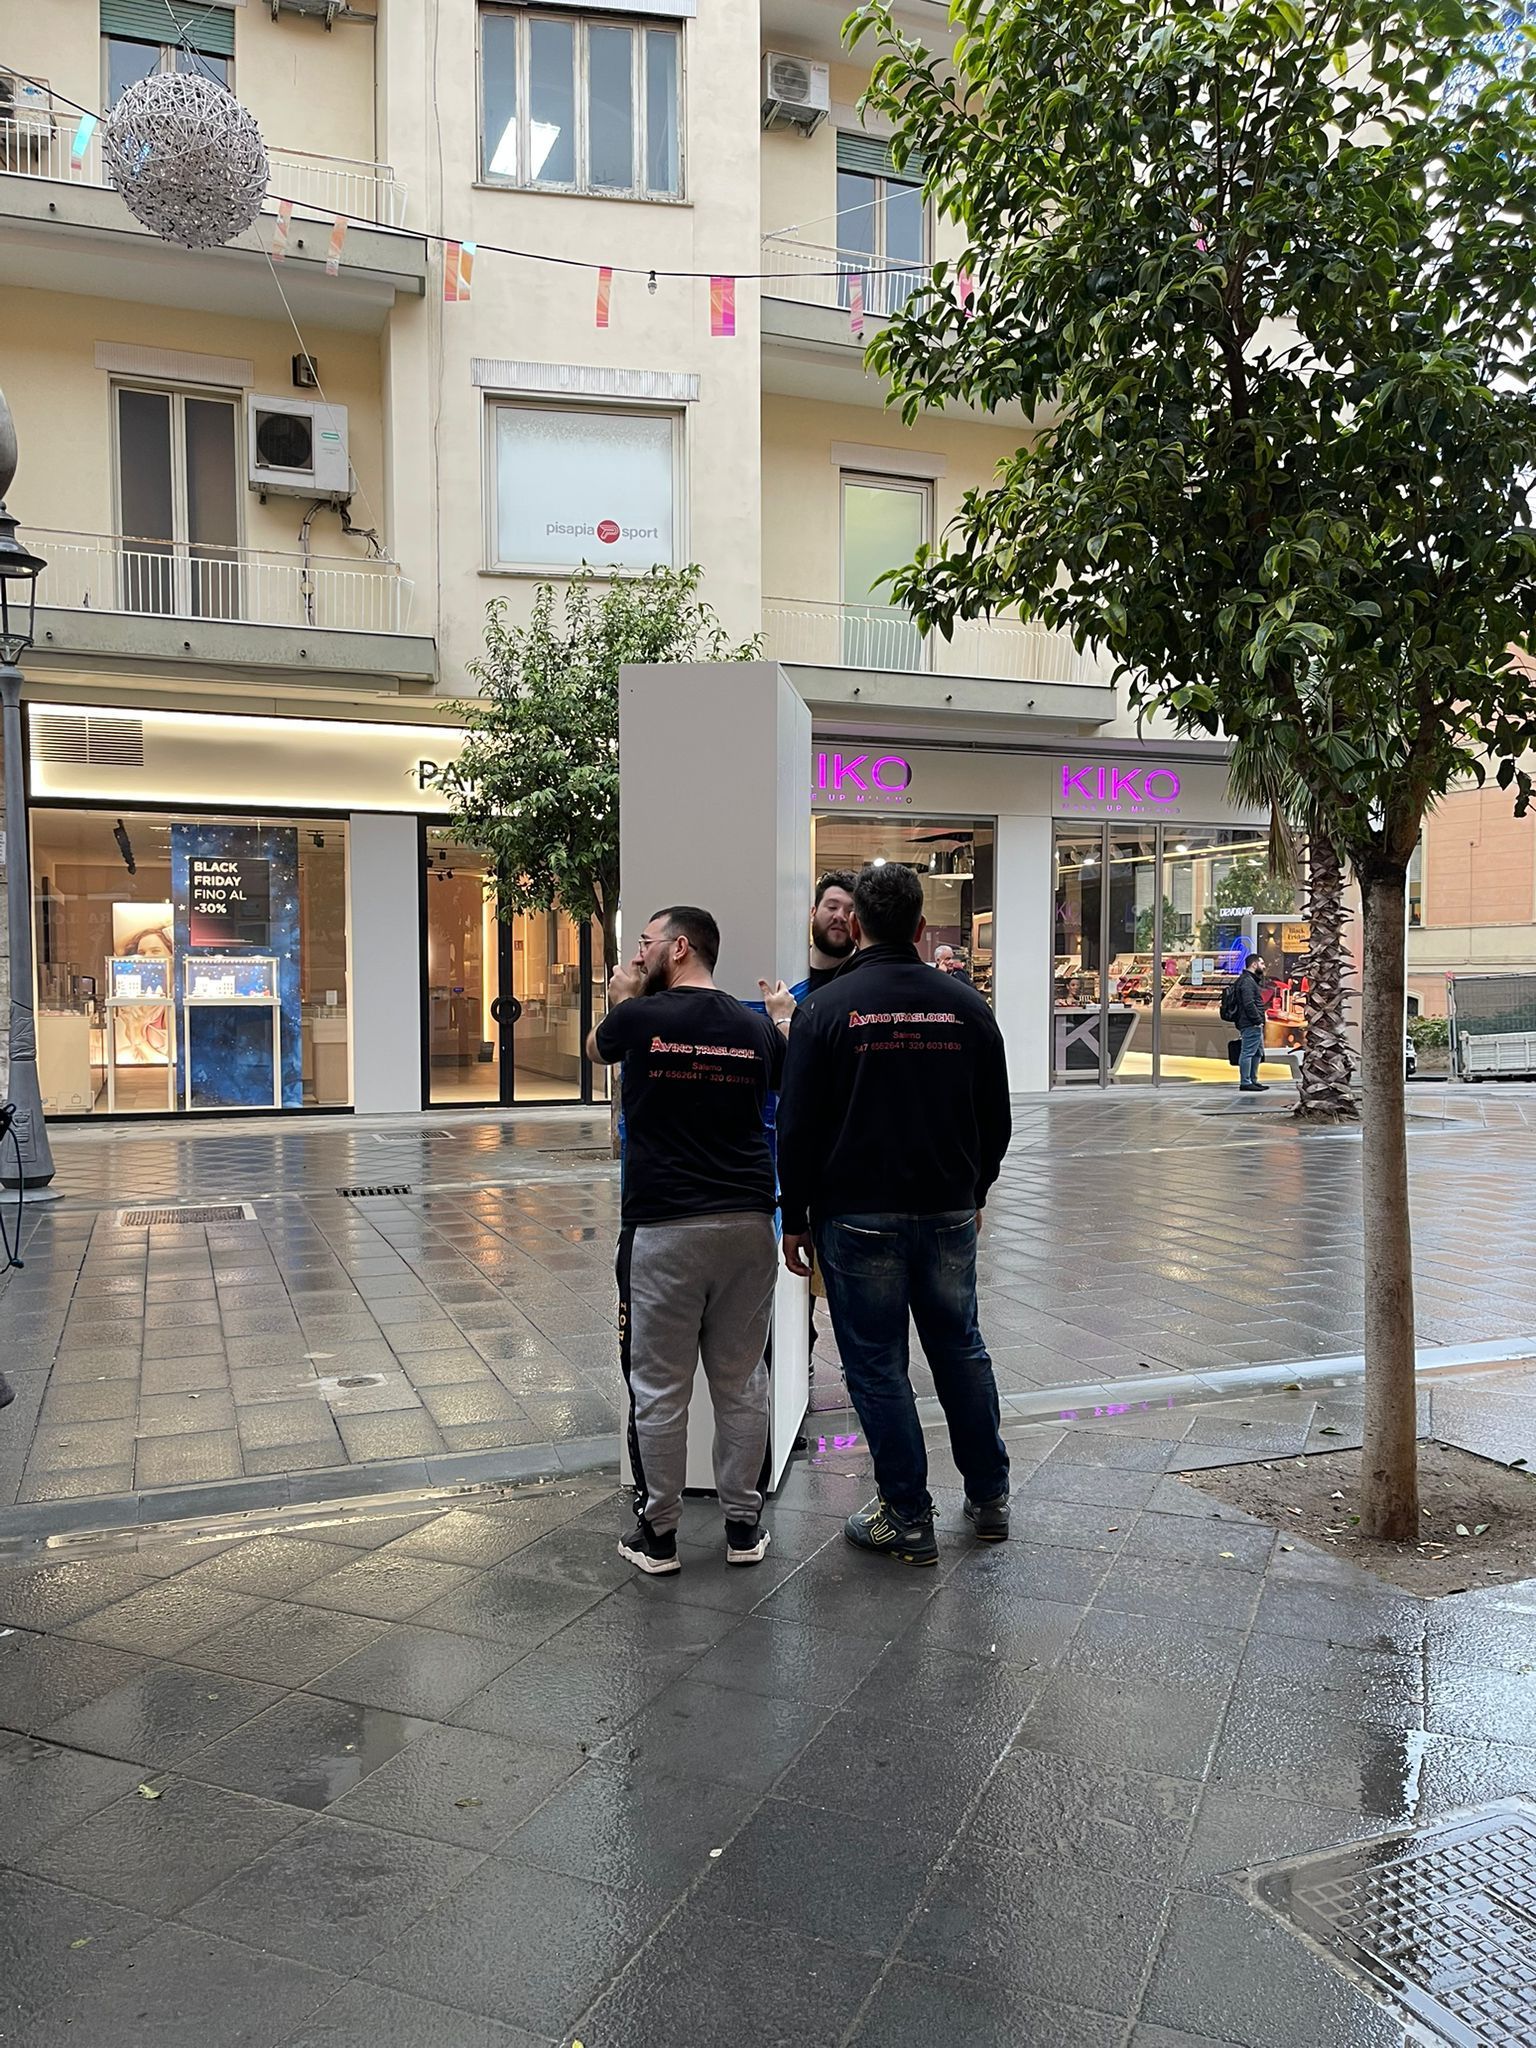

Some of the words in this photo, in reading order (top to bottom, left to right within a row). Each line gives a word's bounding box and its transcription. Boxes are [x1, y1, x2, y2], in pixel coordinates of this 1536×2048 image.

[546, 521, 595, 537] pisapia
[622, 528, 658, 540] sport
[811, 753, 912, 793] IKO
[1061, 765, 1181, 803] KIKO
[828, 794, 846, 802] UP
[1106, 804, 1122, 812] UP
[193, 861, 239, 873] BLACK
[193, 875, 242, 887] FRIDAY
[194, 889, 227, 900] FINO
[229, 890, 248, 901] AL
[193, 903, 228, 914] -30%
[891, 1012, 956, 1024] TRASLOCHI
